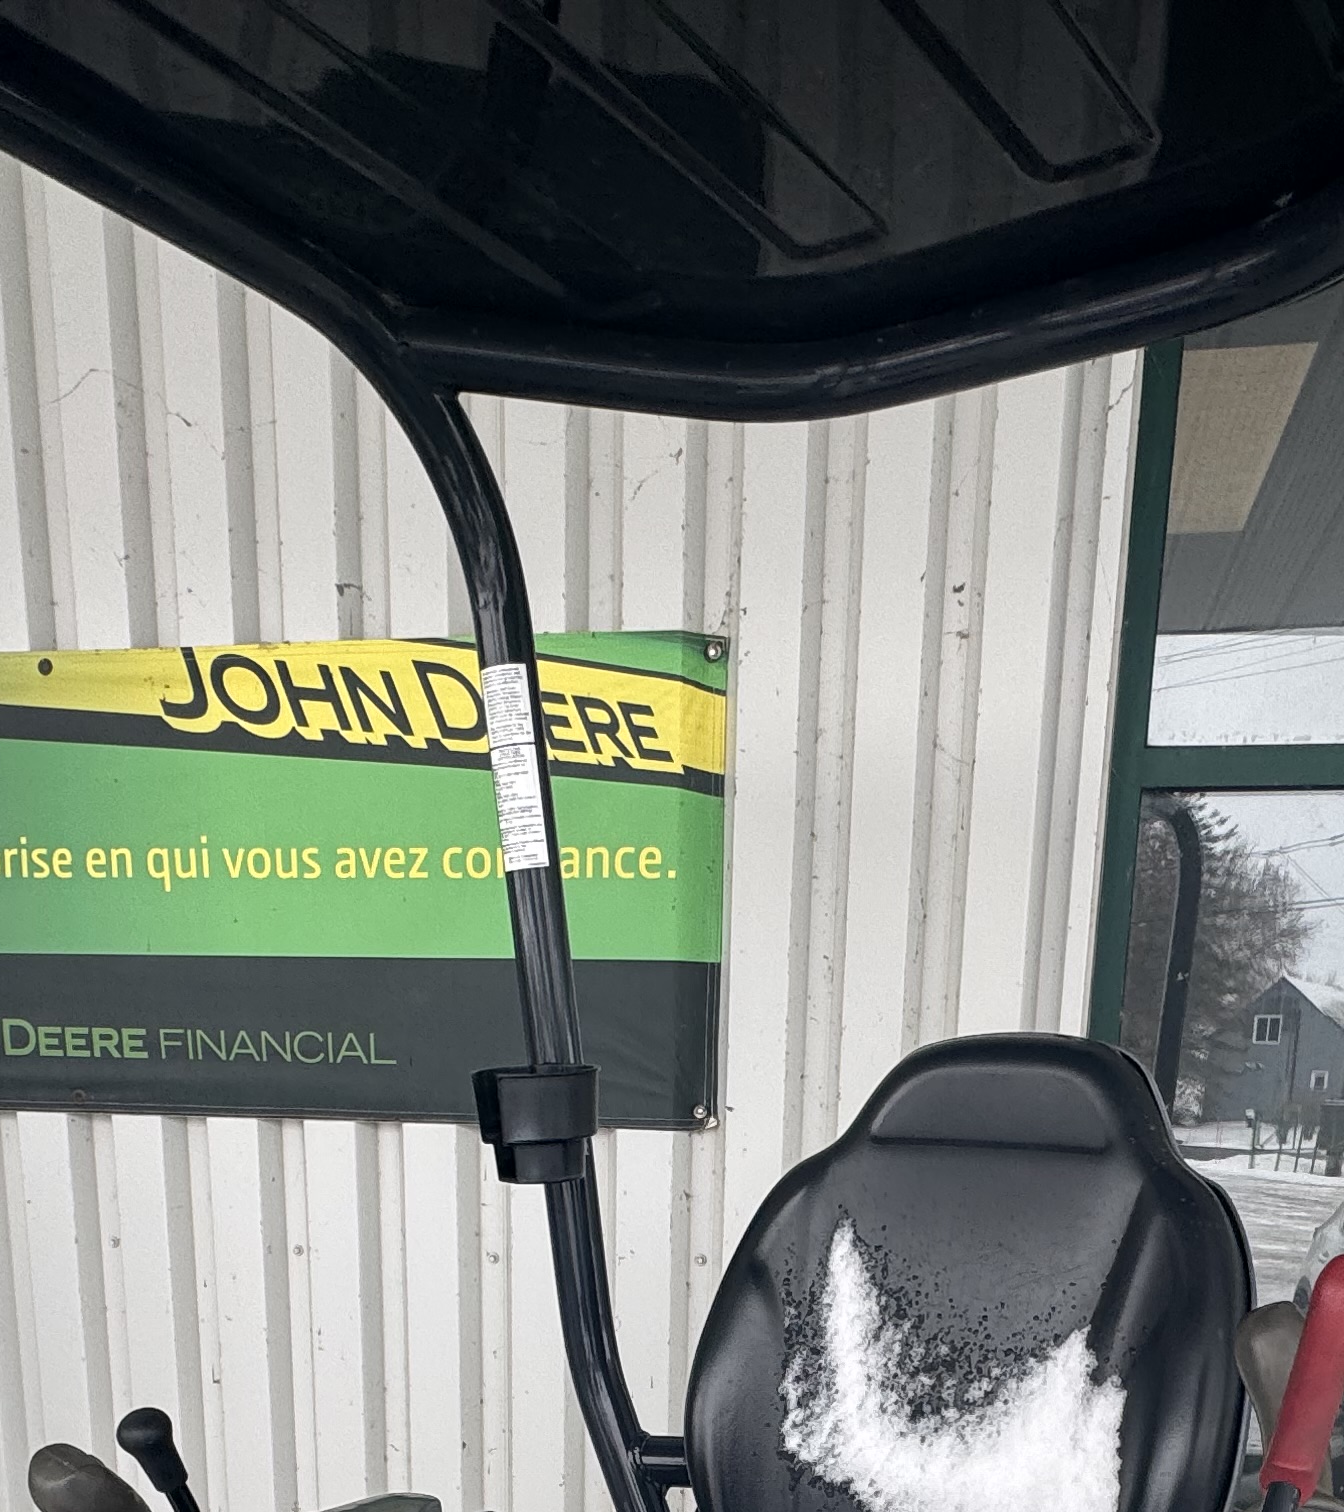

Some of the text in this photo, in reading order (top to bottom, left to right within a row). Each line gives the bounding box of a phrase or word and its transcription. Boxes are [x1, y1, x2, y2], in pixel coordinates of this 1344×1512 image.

[161, 647, 413, 738] JOHN
[413, 659, 674, 763] DERE
[86, 848, 131, 878] en
[148, 836, 210, 892] qui
[223, 847, 321, 878] vous
[336, 847, 428, 878] avez
[442, 846, 677, 879] coance.
[3, 1019, 148, 1060] DEERE
[160, 1028, 397, 1066] FINANCIAL
